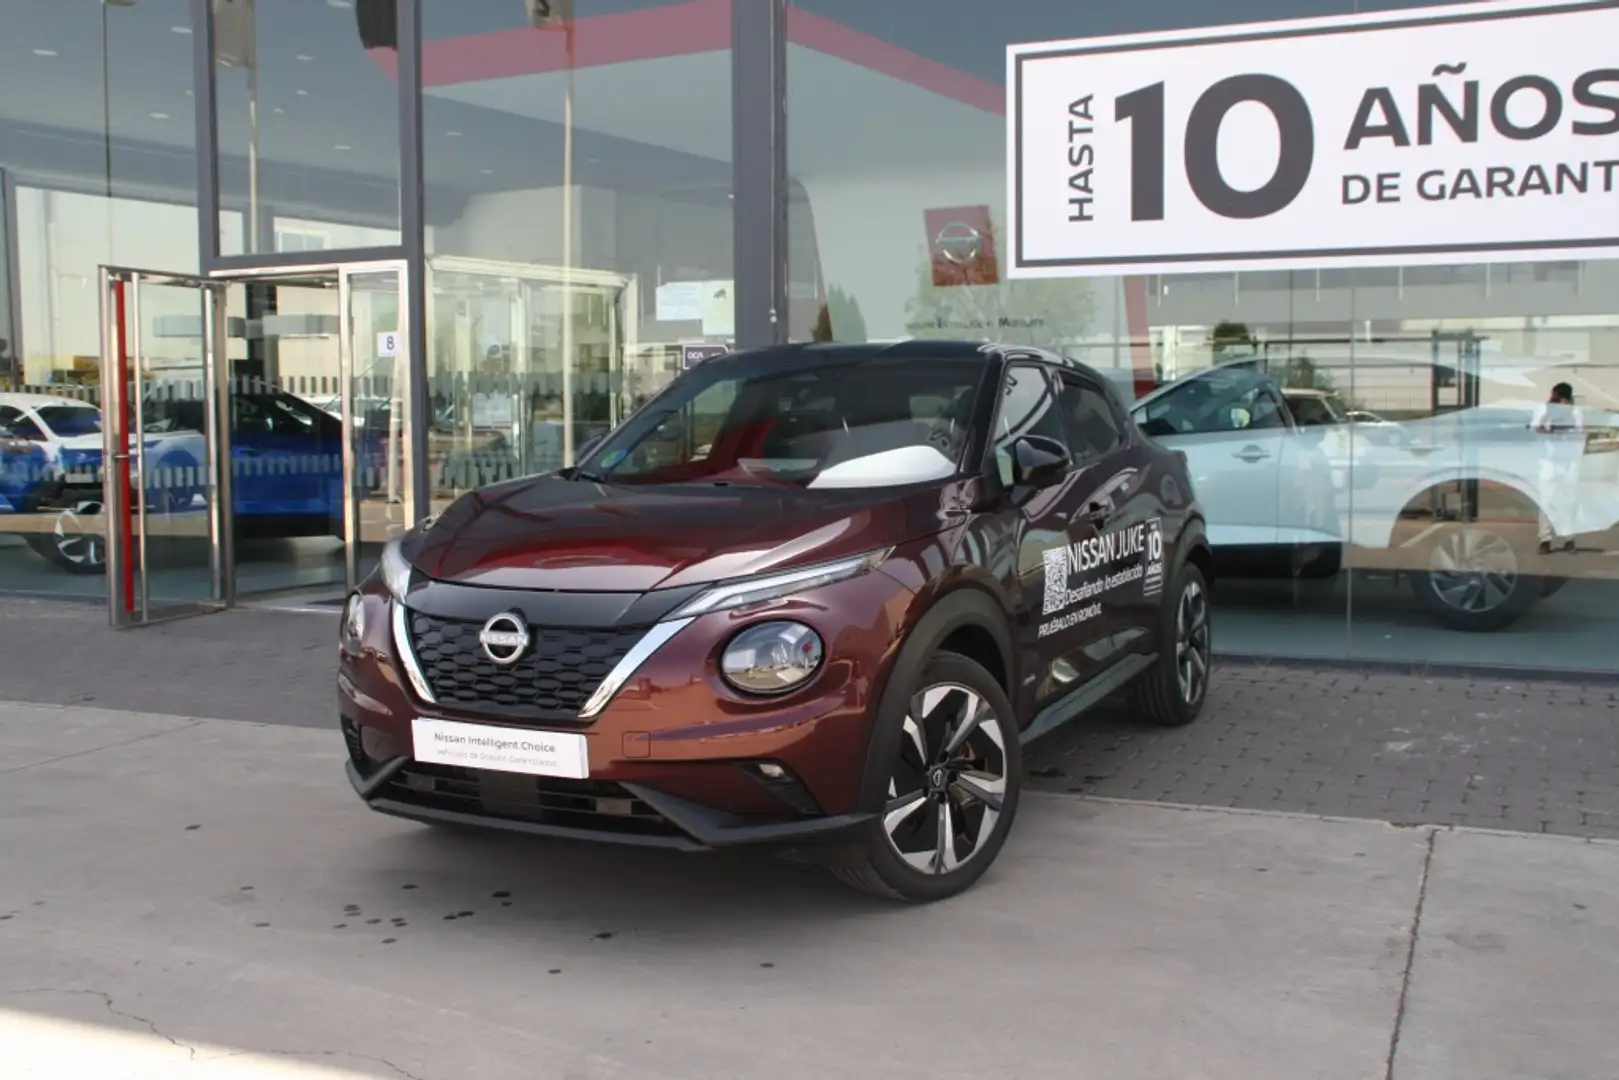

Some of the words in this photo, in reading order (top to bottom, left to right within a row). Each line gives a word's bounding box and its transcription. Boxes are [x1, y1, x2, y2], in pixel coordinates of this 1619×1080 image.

[1114, 73, 1315, 222] 10
[1343, 61, 1619, 150] AÑOS
[1068, 93, 1094, 222] HASTA
[1342, 172, 1401, 205] DE
[386, 335, 395, 351] 8
[1067, 533, 1114, 576] NISSAN
[1116, 524, 1145, 560] JUKE
[1147, 531, 1162, 561] 10
[1065, 580, 1104, 606] Desafiando
[480, 633, 528, 645] NISSAN
[434, 733, 466, 745] Nissan
[468, 736, 519, 751] Intelligent
[521, 741, 556, 753] Choice
